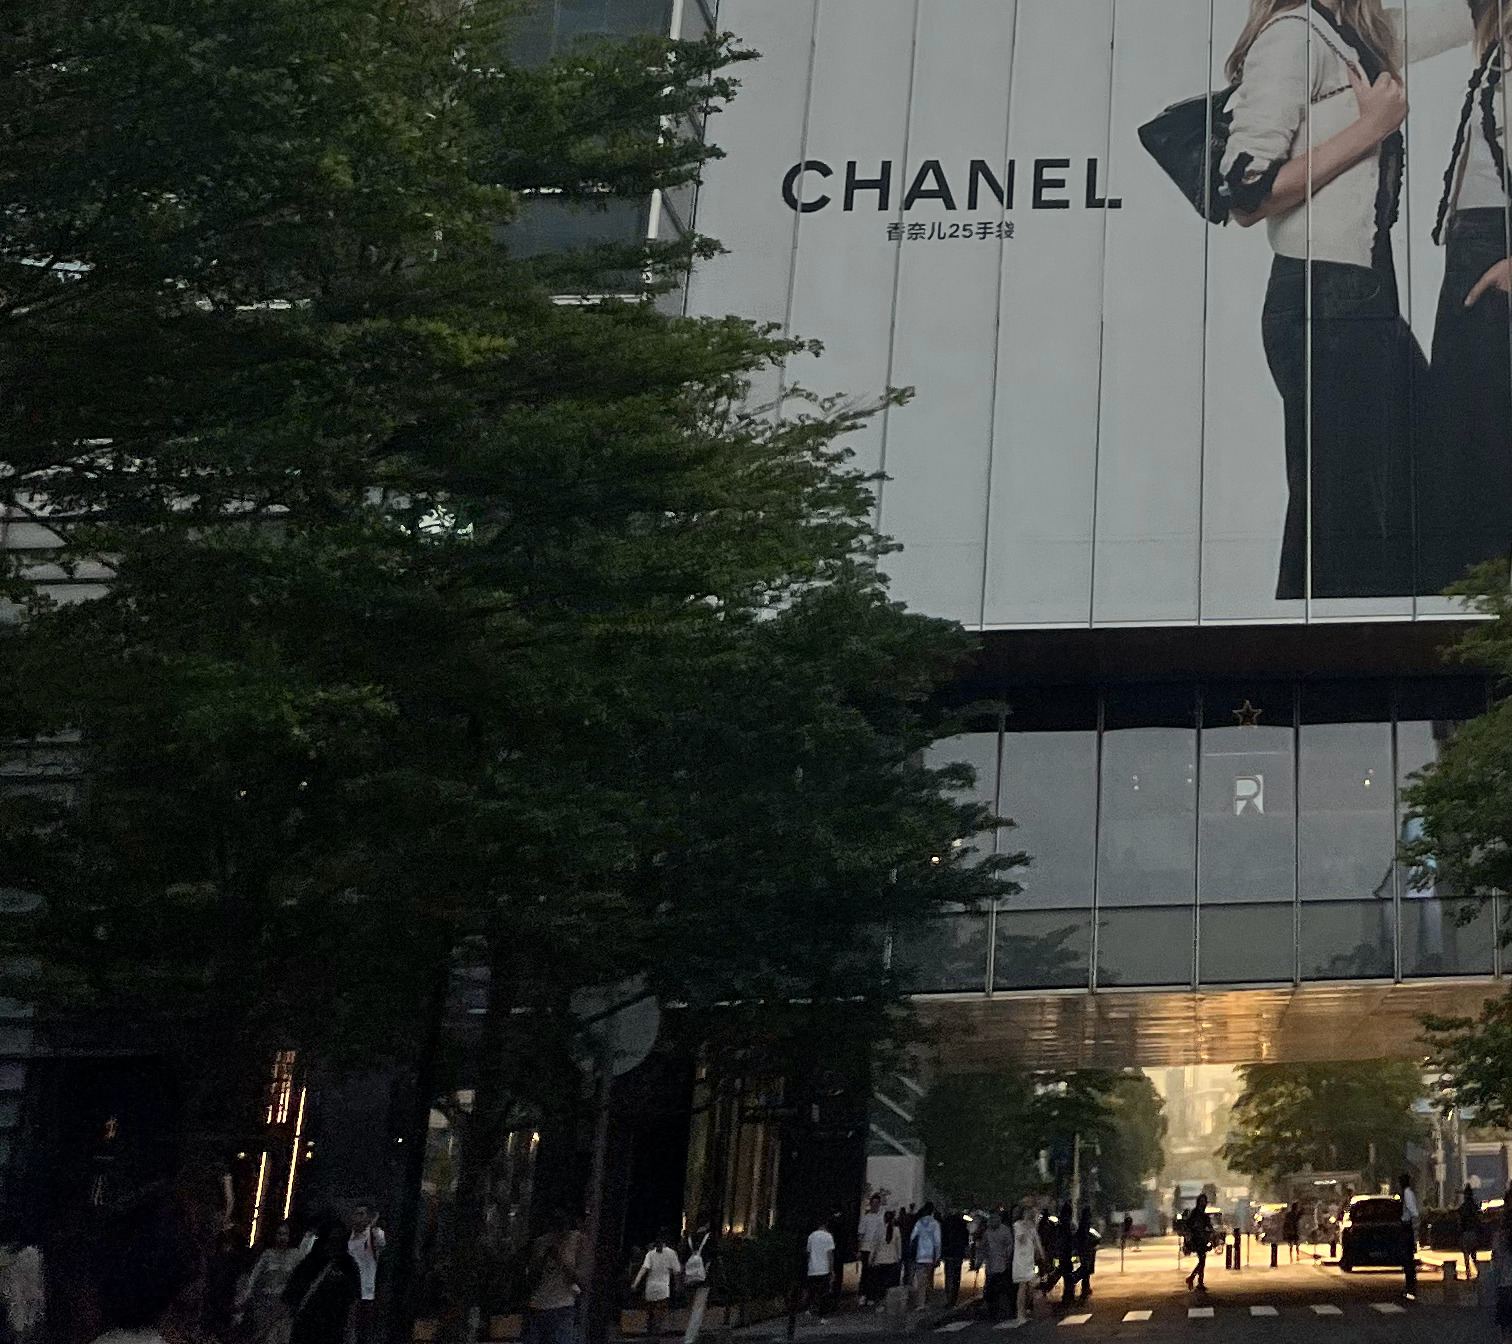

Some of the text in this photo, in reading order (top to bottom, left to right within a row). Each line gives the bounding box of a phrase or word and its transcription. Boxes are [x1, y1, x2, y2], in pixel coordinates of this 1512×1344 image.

[782, 158, 1122, 213] CHANEL
[887, 220, 1015, 242] 香奈儿25手袋
